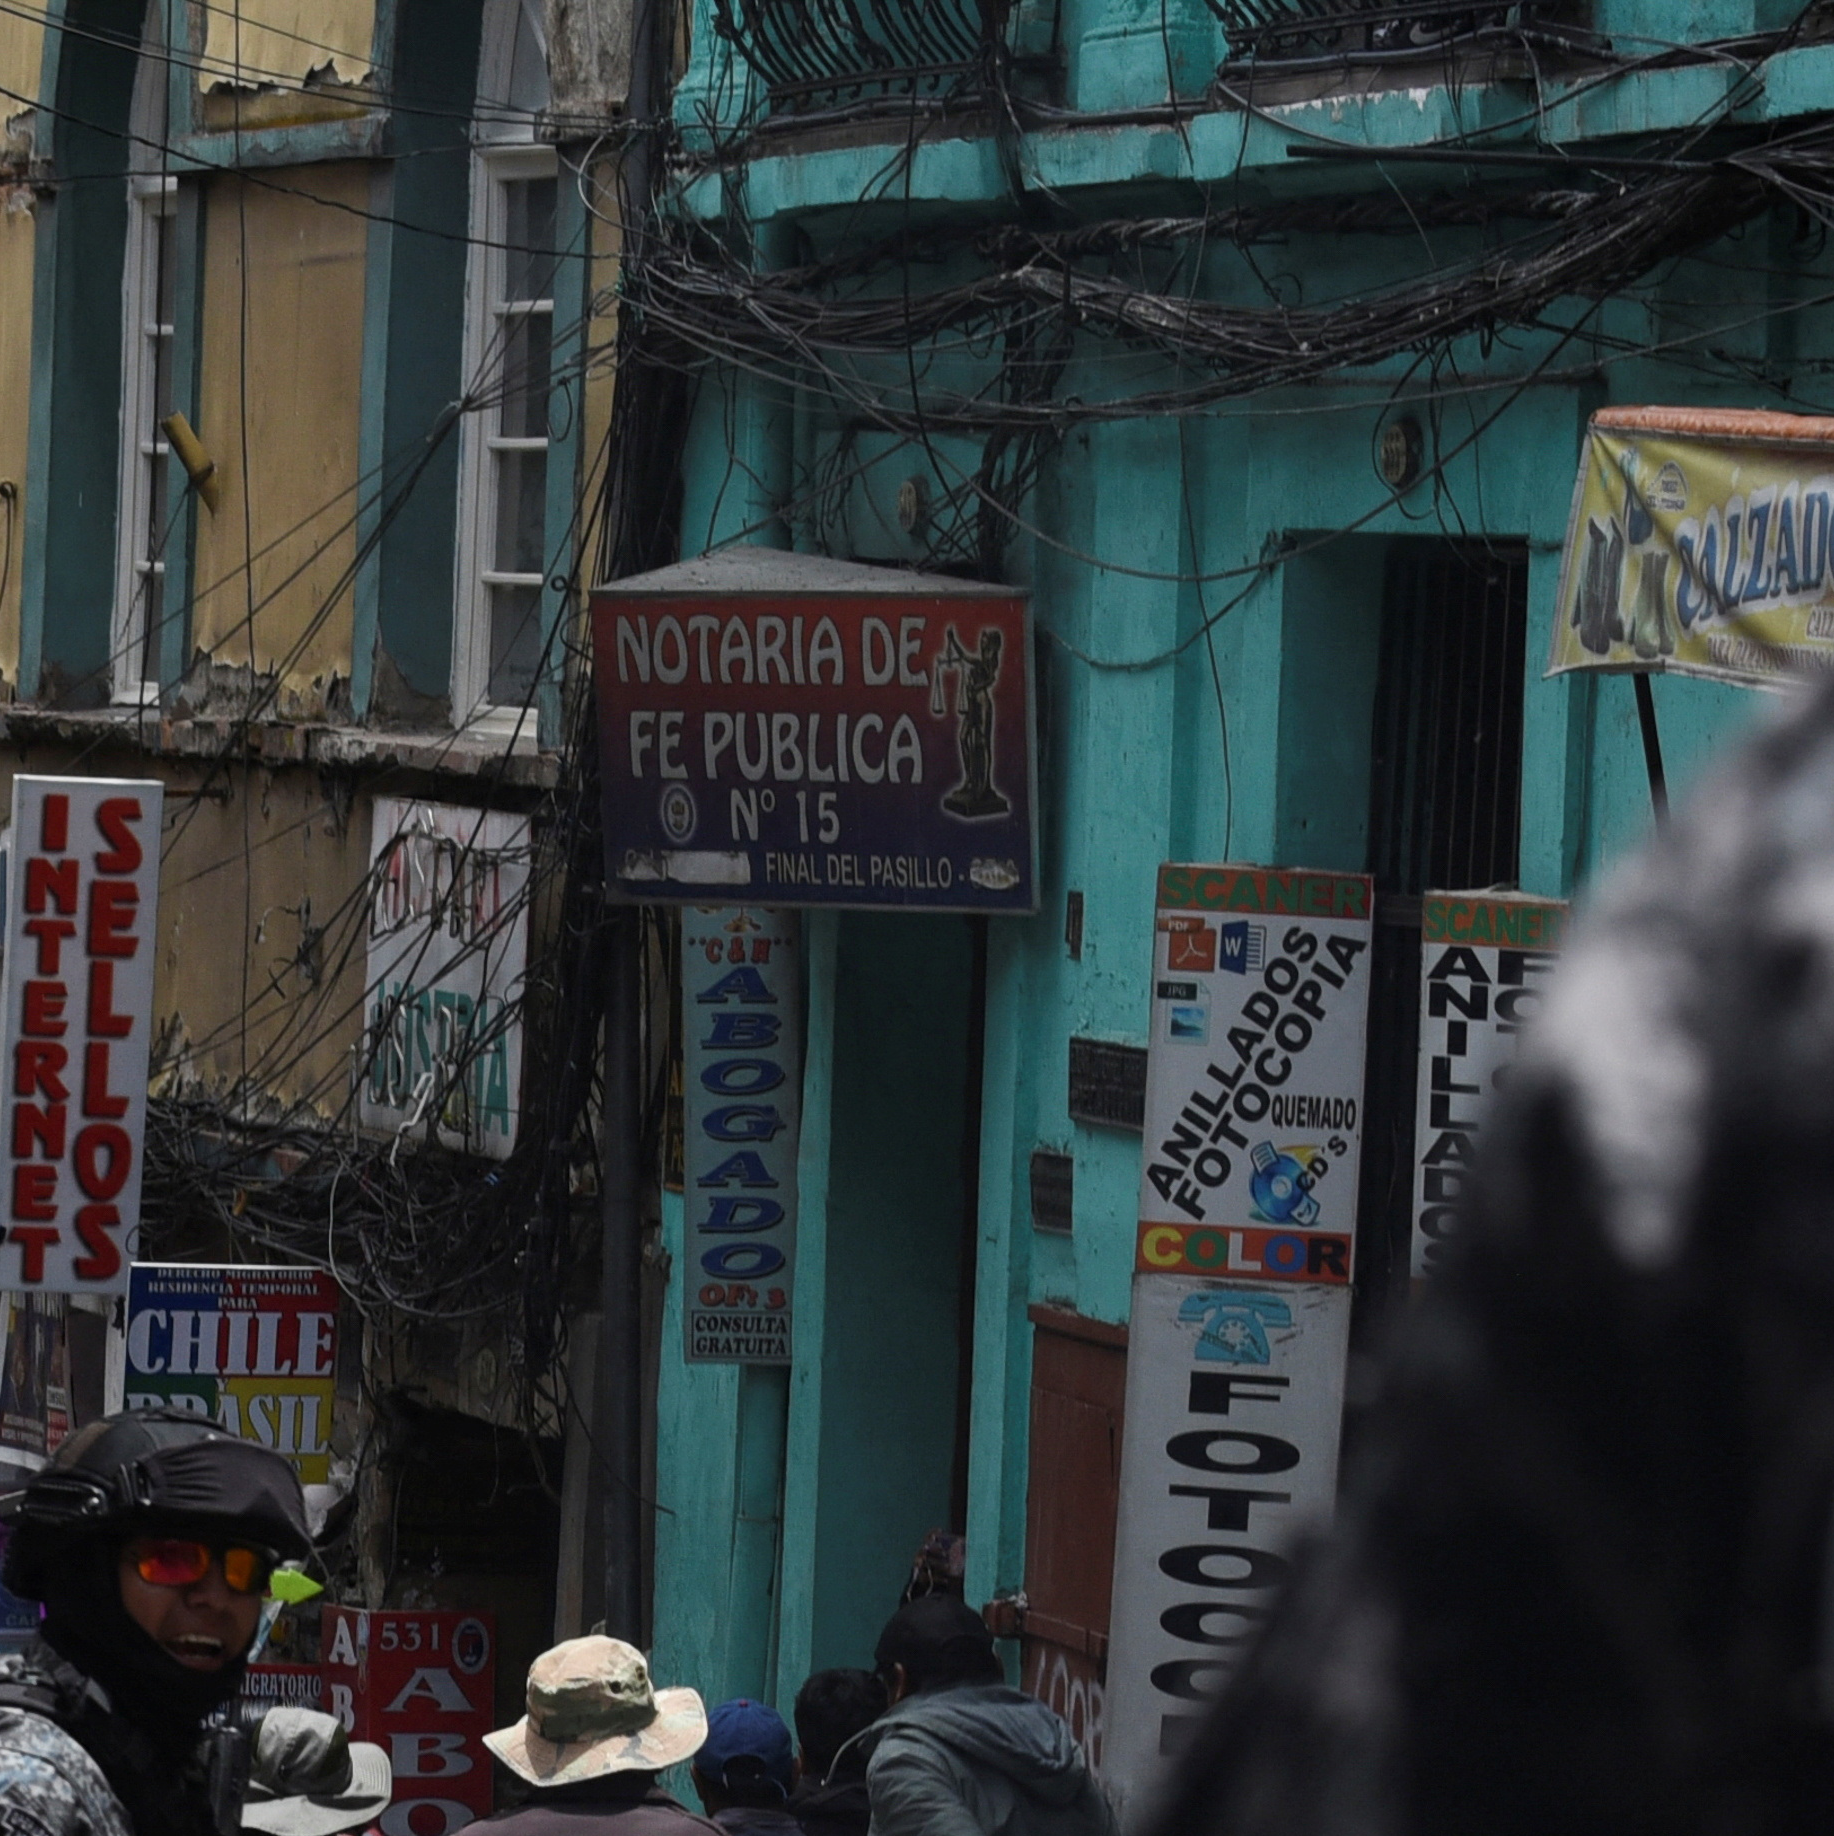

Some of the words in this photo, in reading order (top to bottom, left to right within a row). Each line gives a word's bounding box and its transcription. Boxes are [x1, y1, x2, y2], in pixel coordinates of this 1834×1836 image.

[616, 614, 845, 686] NOTARIA
[862, 616, 928, 687] DE
[629, 710, 689, 779] FE
[703, 711, 924, 784] PUBLICA
[796, 791, 840, 844] 15
[766, 852, 823, 885] FINAL
[827, 854, 866, 887] DEL
[870, 856, 953, 889] PASILLO
[1162, 871, 1369, 916] SCANER
[1168, 920, 1190, 932] PDF
[1424, 901, 1565, 946] SCANER
[1168, 985, 1187, 998] JPG
[11, 794, 79, 1284] INTERNET
[72, 798, 143, 1282] SELLOS
[1147, 926, 1317, 1202] ANILLADOS
[1172, 934, 1366, 1221] FOTOCOPIA
[696, 966, 786, 1281] ABOGADO
[1272, 1094, 1357, 1130] QUEMADO
[158, 1268, 220, 1279] DERECHO
[225, 1270, 314, 1280] MIGRATORIO
[1141, 1226, 1347, 1277] COLOR
[148, 1281, 234, 1295] RESIDENCIA
[240, 1283, 320, 1296] TEMPORAL
[218, 1297, 259, 1310] PARA
[127, 1308, 335, 1377] CHILE
[695, 1316, 788, 1333] CONSULTA
[696, 1337, 787, 1354] GRATUITA
[380, 1621, 440, 1652] 531
